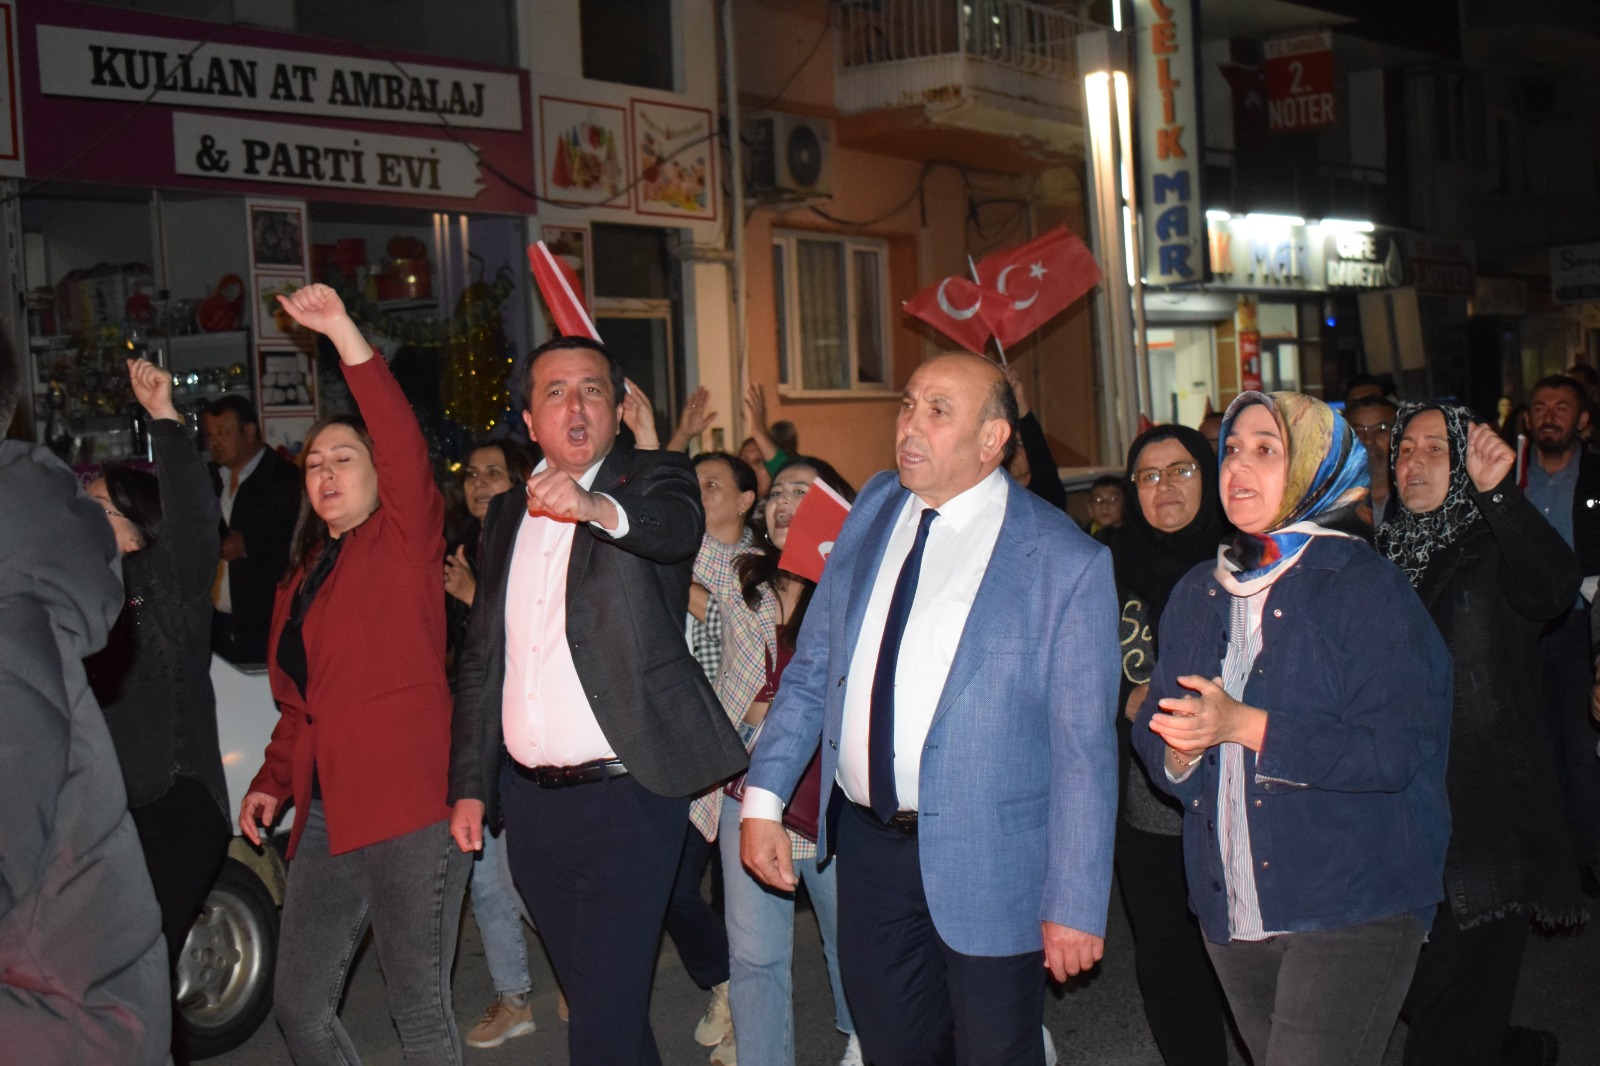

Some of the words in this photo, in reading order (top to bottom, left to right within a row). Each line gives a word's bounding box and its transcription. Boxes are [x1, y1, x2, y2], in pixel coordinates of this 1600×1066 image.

[89, 44, 257, 98] KULLAN
[270, 64, 316, 103] AT
[329, 70, 485, 118] AMBALAJ
[1288, 60, 1312, 93] 2.
[1268, 92, 1335, 129] NOTER
[195, 134, 230, 174] &
[243, 138, 364, 184] PARTİ
[377, 147, 441, 190] EVİ
[1153, 170, 1194, 278] MAR
